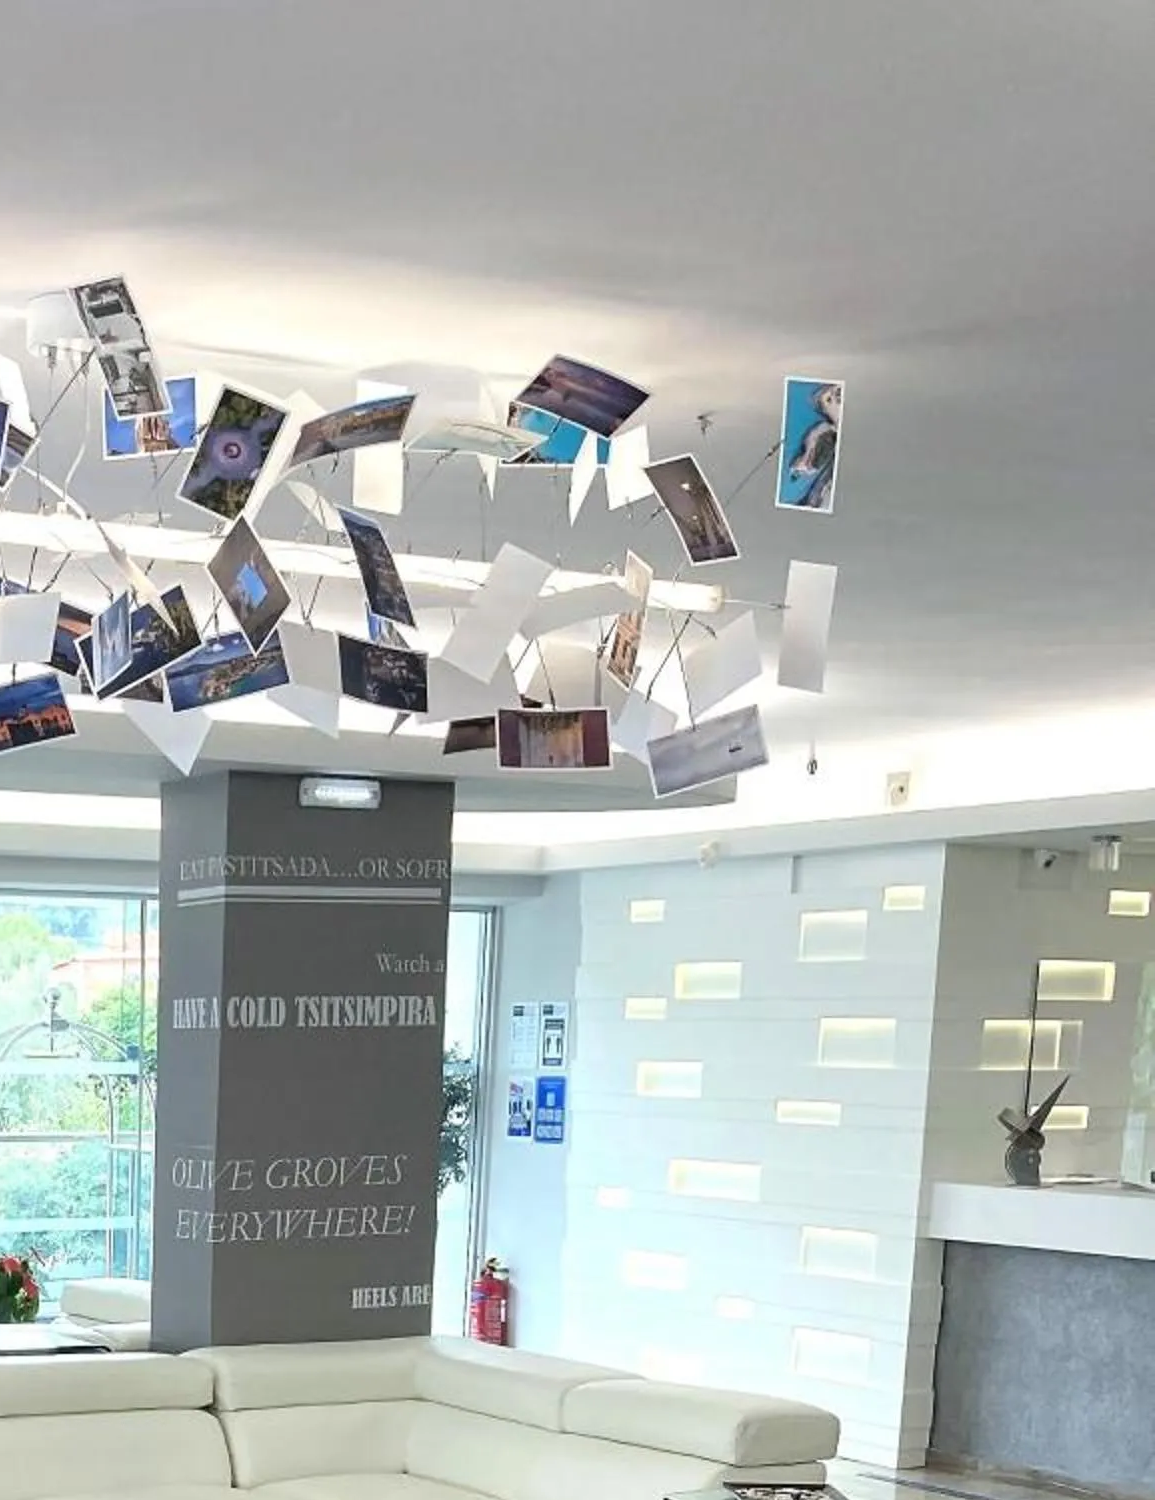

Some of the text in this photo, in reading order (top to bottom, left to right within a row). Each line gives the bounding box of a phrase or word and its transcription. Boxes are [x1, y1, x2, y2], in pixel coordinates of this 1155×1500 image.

[376, 953, 445, 973] Watch a
[173, 995, 437, 1029] HAVE A COLD TSITSIMPIRA
[172, 1154, 408, 1190] OLIVE GROVES
[176, 1205, 416, 1243] EVERYWHERE!
[352, 1286, 397, 1309] HEELS
